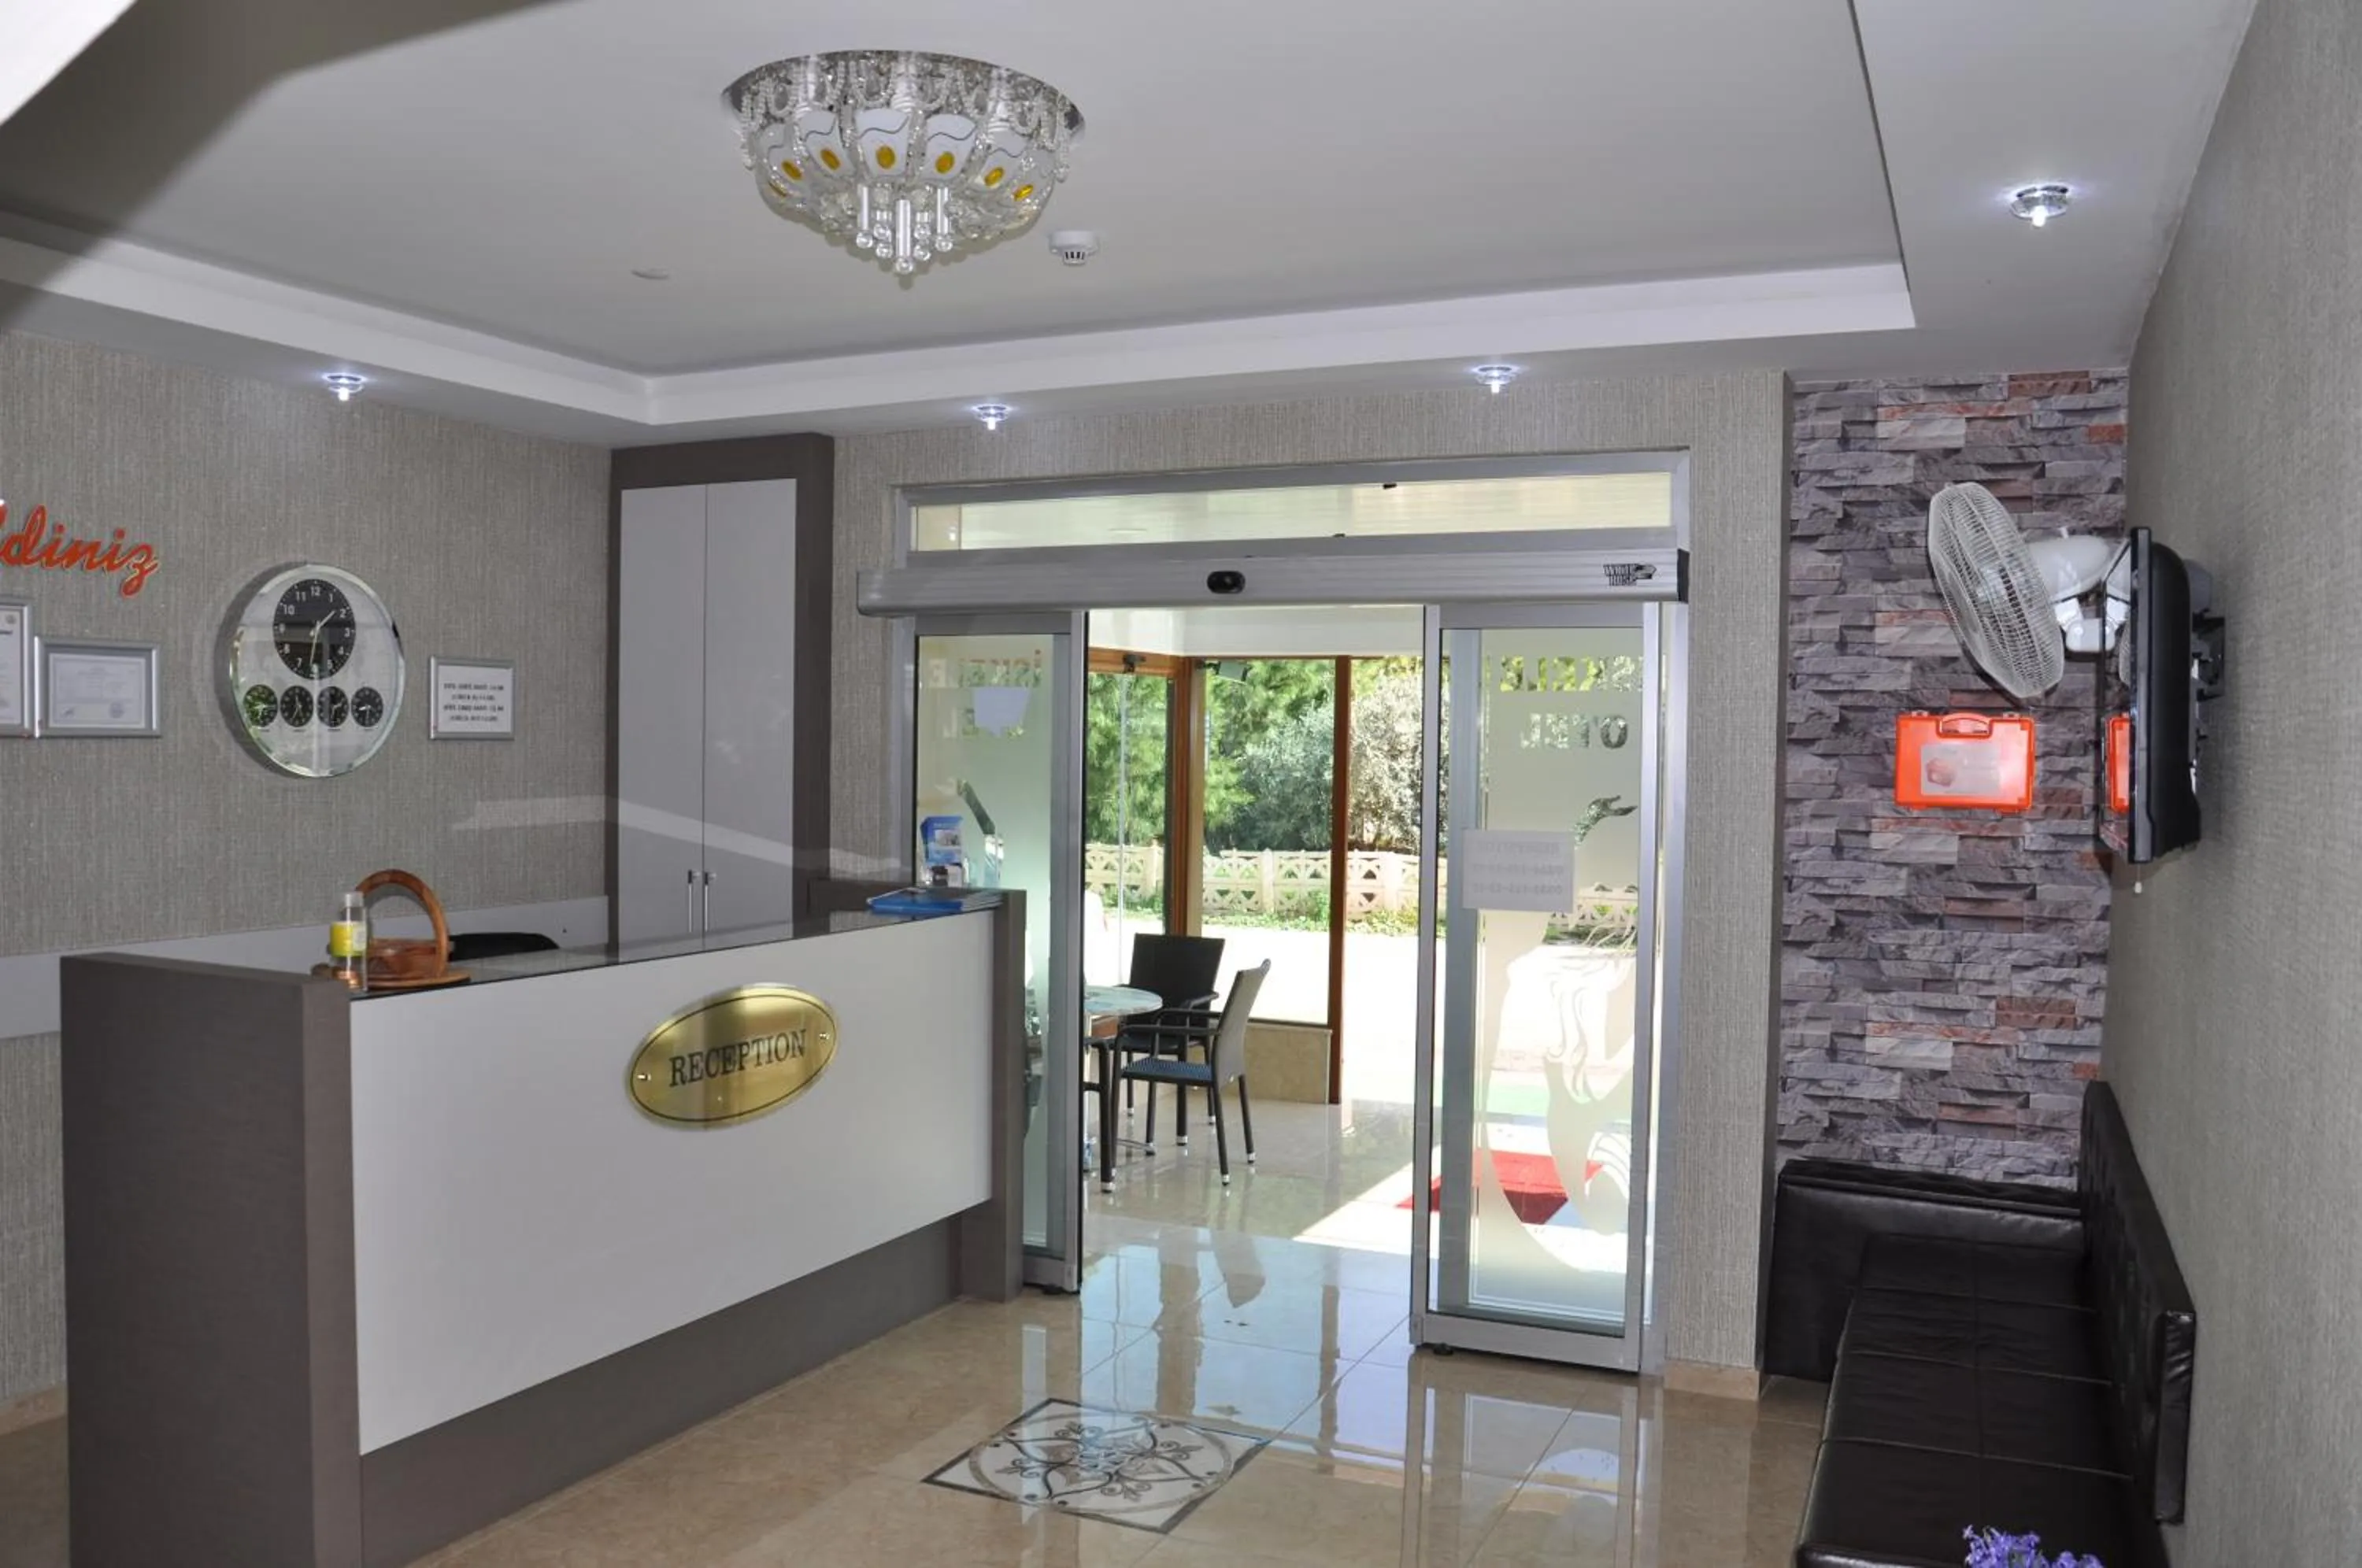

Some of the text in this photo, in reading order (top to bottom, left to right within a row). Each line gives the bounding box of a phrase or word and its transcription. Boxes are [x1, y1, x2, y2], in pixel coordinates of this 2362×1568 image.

[295, 591, 306, 601] 11
[310, 586, 321, 597] 12
[283, 604, 295, 616] 10
[339, 608, 346, 619] 2
[344, 627, 351, 638] 3
[668, 1028, 807, 1087] RECEPTION
